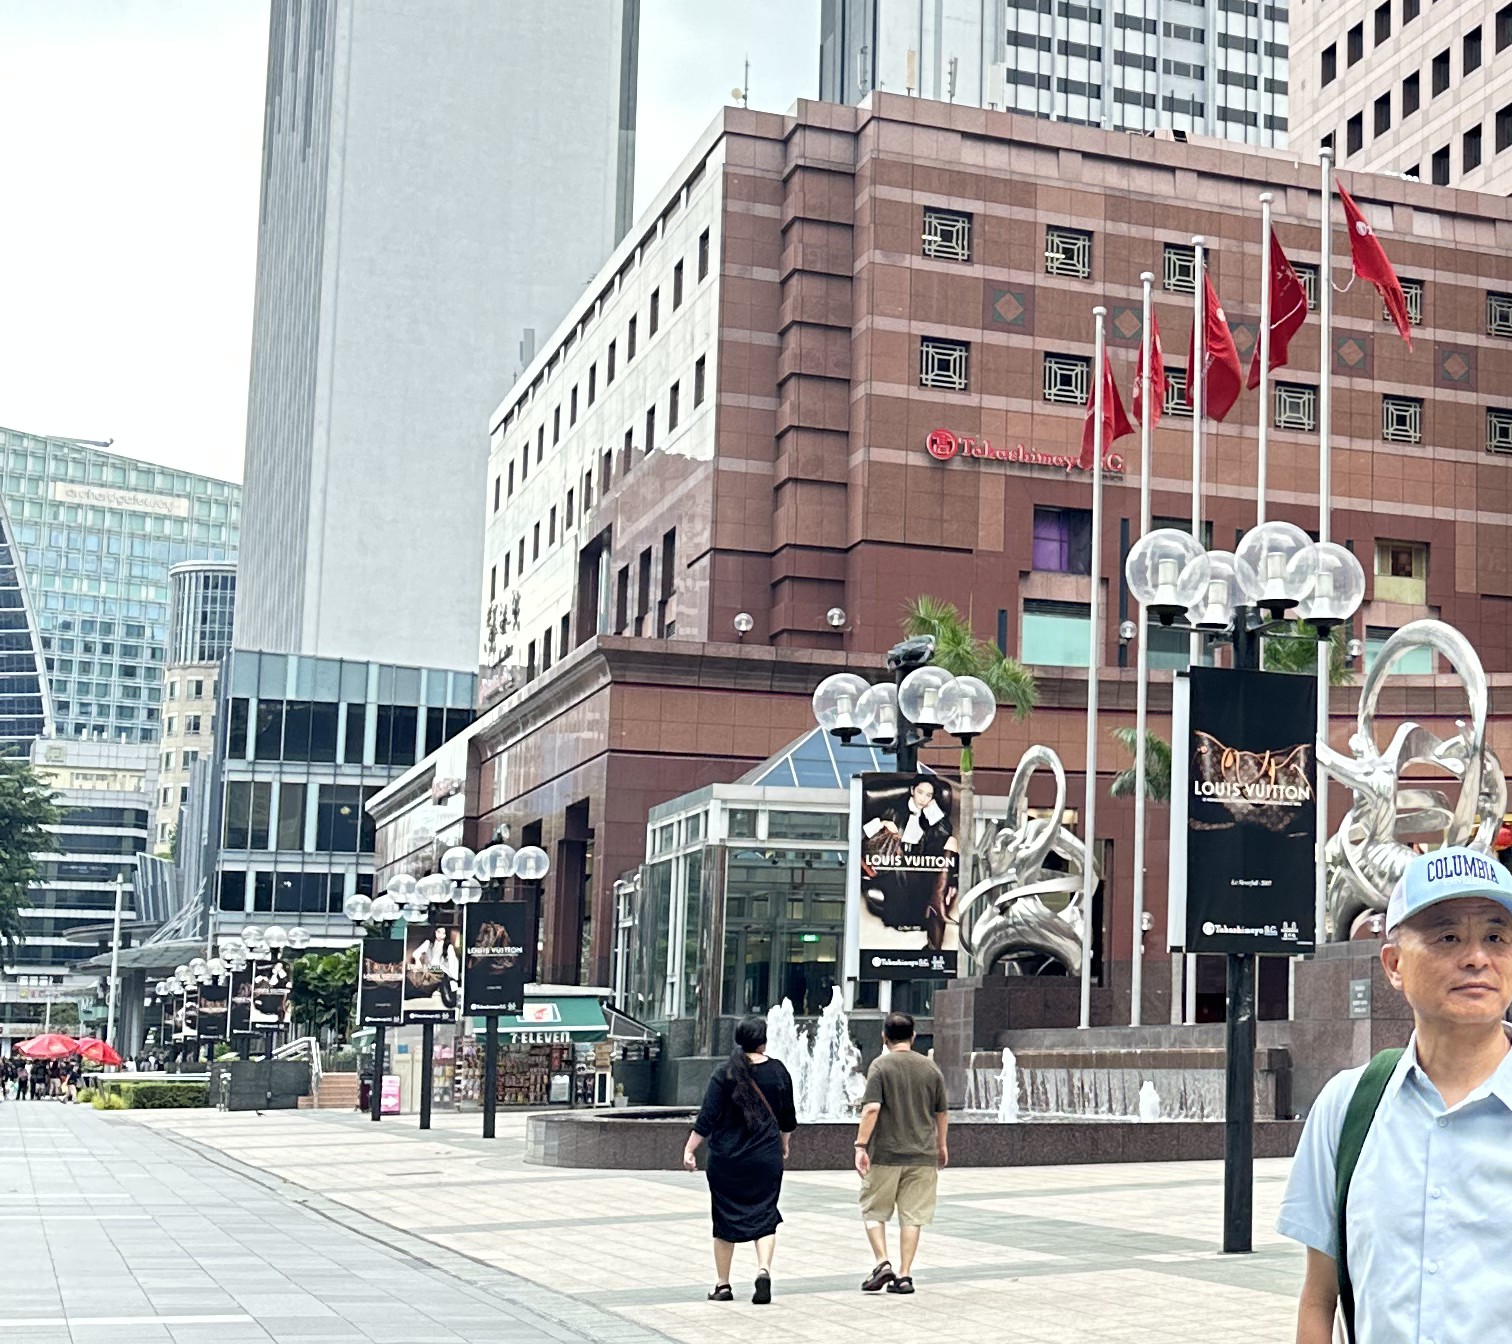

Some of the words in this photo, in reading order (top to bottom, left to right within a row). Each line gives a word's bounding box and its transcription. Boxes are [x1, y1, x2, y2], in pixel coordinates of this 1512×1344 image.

[1194, 780, 1240, 797] LOUIS
[1244, 783, 1310, 801] VUITTON
[866, 855, 901, 866] LOUIS
[905, 855, 955, 867] VUITTON
[1427, 855, 1499, 884] COLUMBIA
